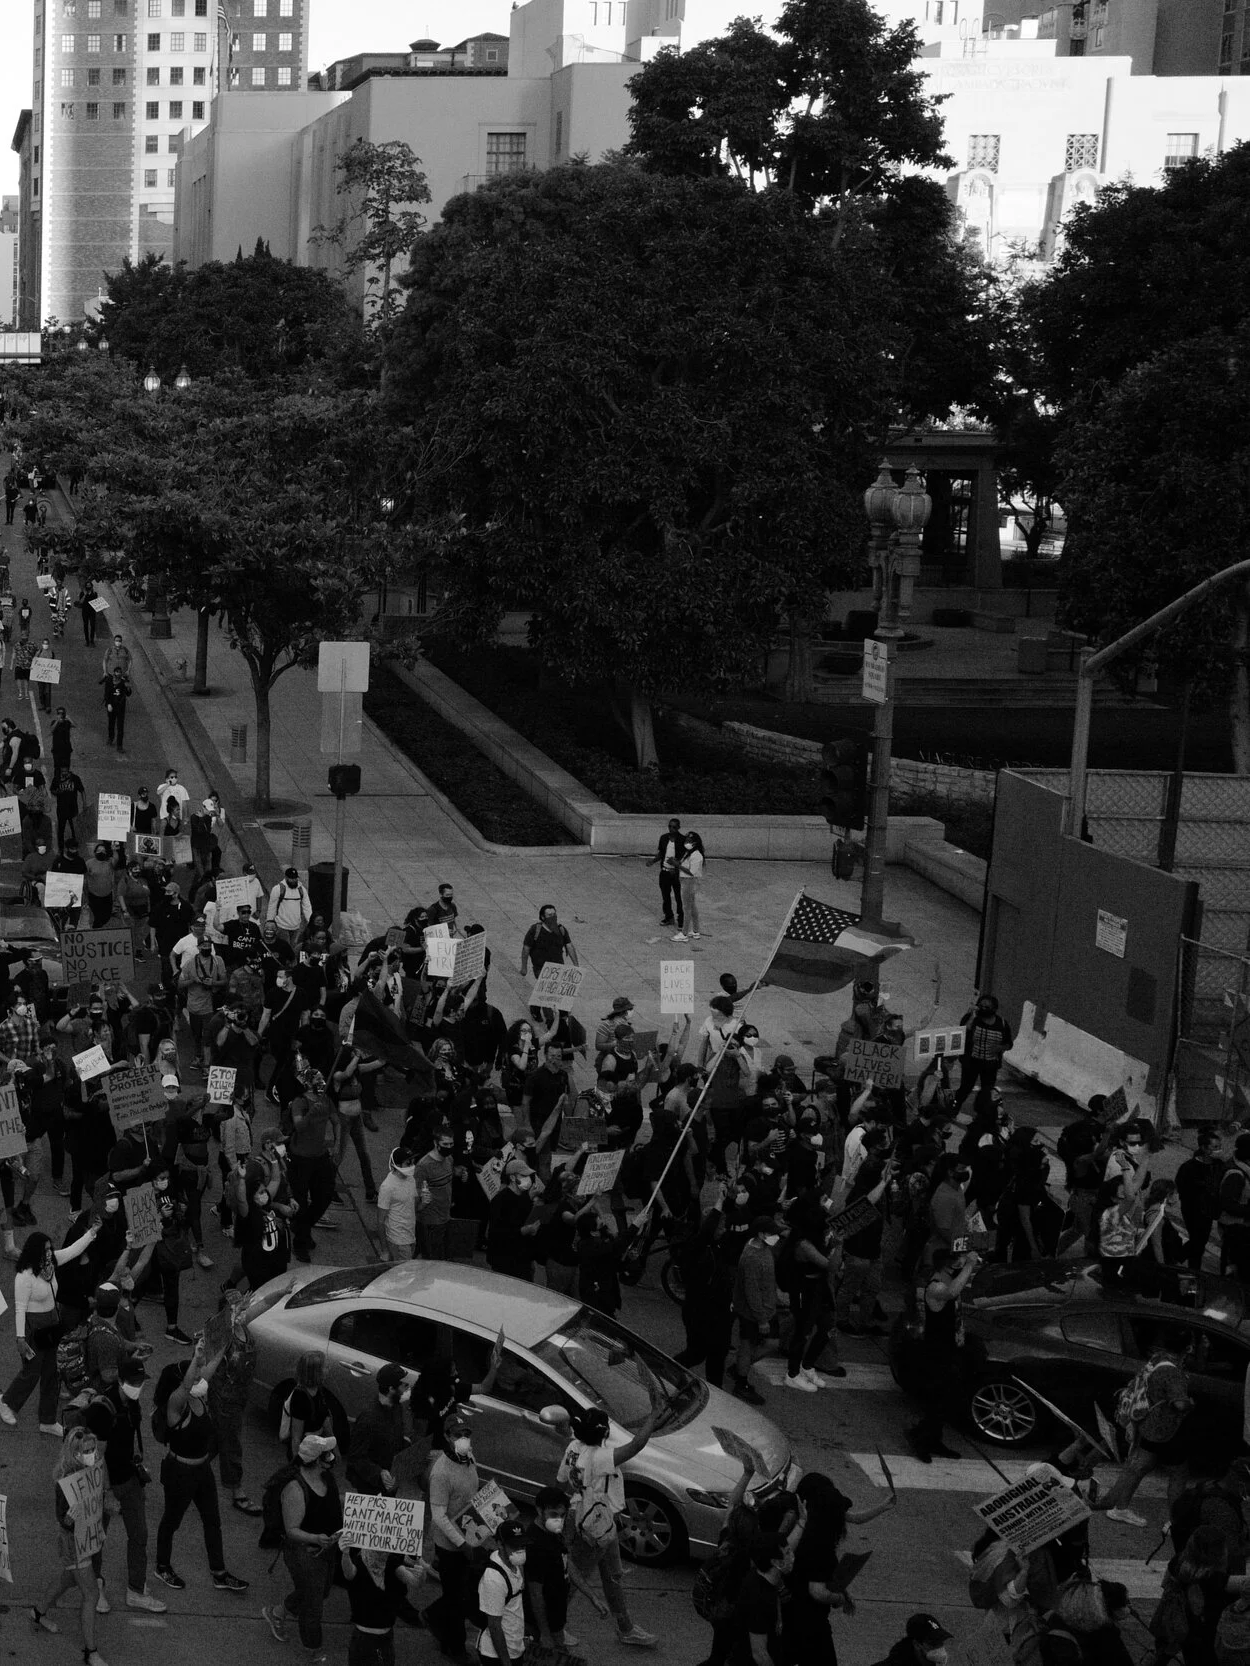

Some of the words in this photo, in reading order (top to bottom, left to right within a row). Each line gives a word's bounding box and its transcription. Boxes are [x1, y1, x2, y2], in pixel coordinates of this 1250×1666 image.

[64, 933, 84, 944] NO
[437, 941, 456, 956] FUC
[64, 941, 131, 958] JUSTICE
[66, 959, 87, 970] NO
[66, 967, 121, 982] PEACE
[664, 965, 691, 974] BLACK
[664, 979, 691, 988] LIVES
[662, 994, 694, 1003] MATTER
[853, 1040, 900, 1060] BLACK
[109, 1064, 161, 1085] PEACEFUL
[210, 1068, 236, 1080] STOP
[855, 1056, 891, 1073] LIVES
[109, 1074, 155, 1093] PROTEST
[846, 1067, 898, 1088] MATTER!
[214, 1090, 229, 1101] US
[131, 1190, 156, 1216] BLACK
[133, 1207, 156, 1229] LIVES
[70, 1477, 85, 1501] IF
[980, 1476, 1041, 1517] ABORIGINAL
[83, 1497, 100, 1520] NO
[347, 1494, 366, 1506] HEY
[394, 1499, 415, 1513] YOU
[992, 1489, 1050, 1527] AUSTRALIA
[344, 1506, 375, 1521] CANT
[375, 1510, 414, 1526] MARCH
[998, 1516, 1027, 1535] STANDS
[1024, 1505, 1042, 1520] WITH
[1040, 1497, 1057, 1511] YOU
[75, 1520, 103, 1555] WHE
[344, 1520, 366, 1530] WITH
[367, 1522, 378, 1535] US
[380, 1524, 404, 1539] UNTIL
[407, 1528, 423, 1541] YOU
[369, 1534, 391, 1549] YOUR
[392, 1538, 421, 1556] JOB!
